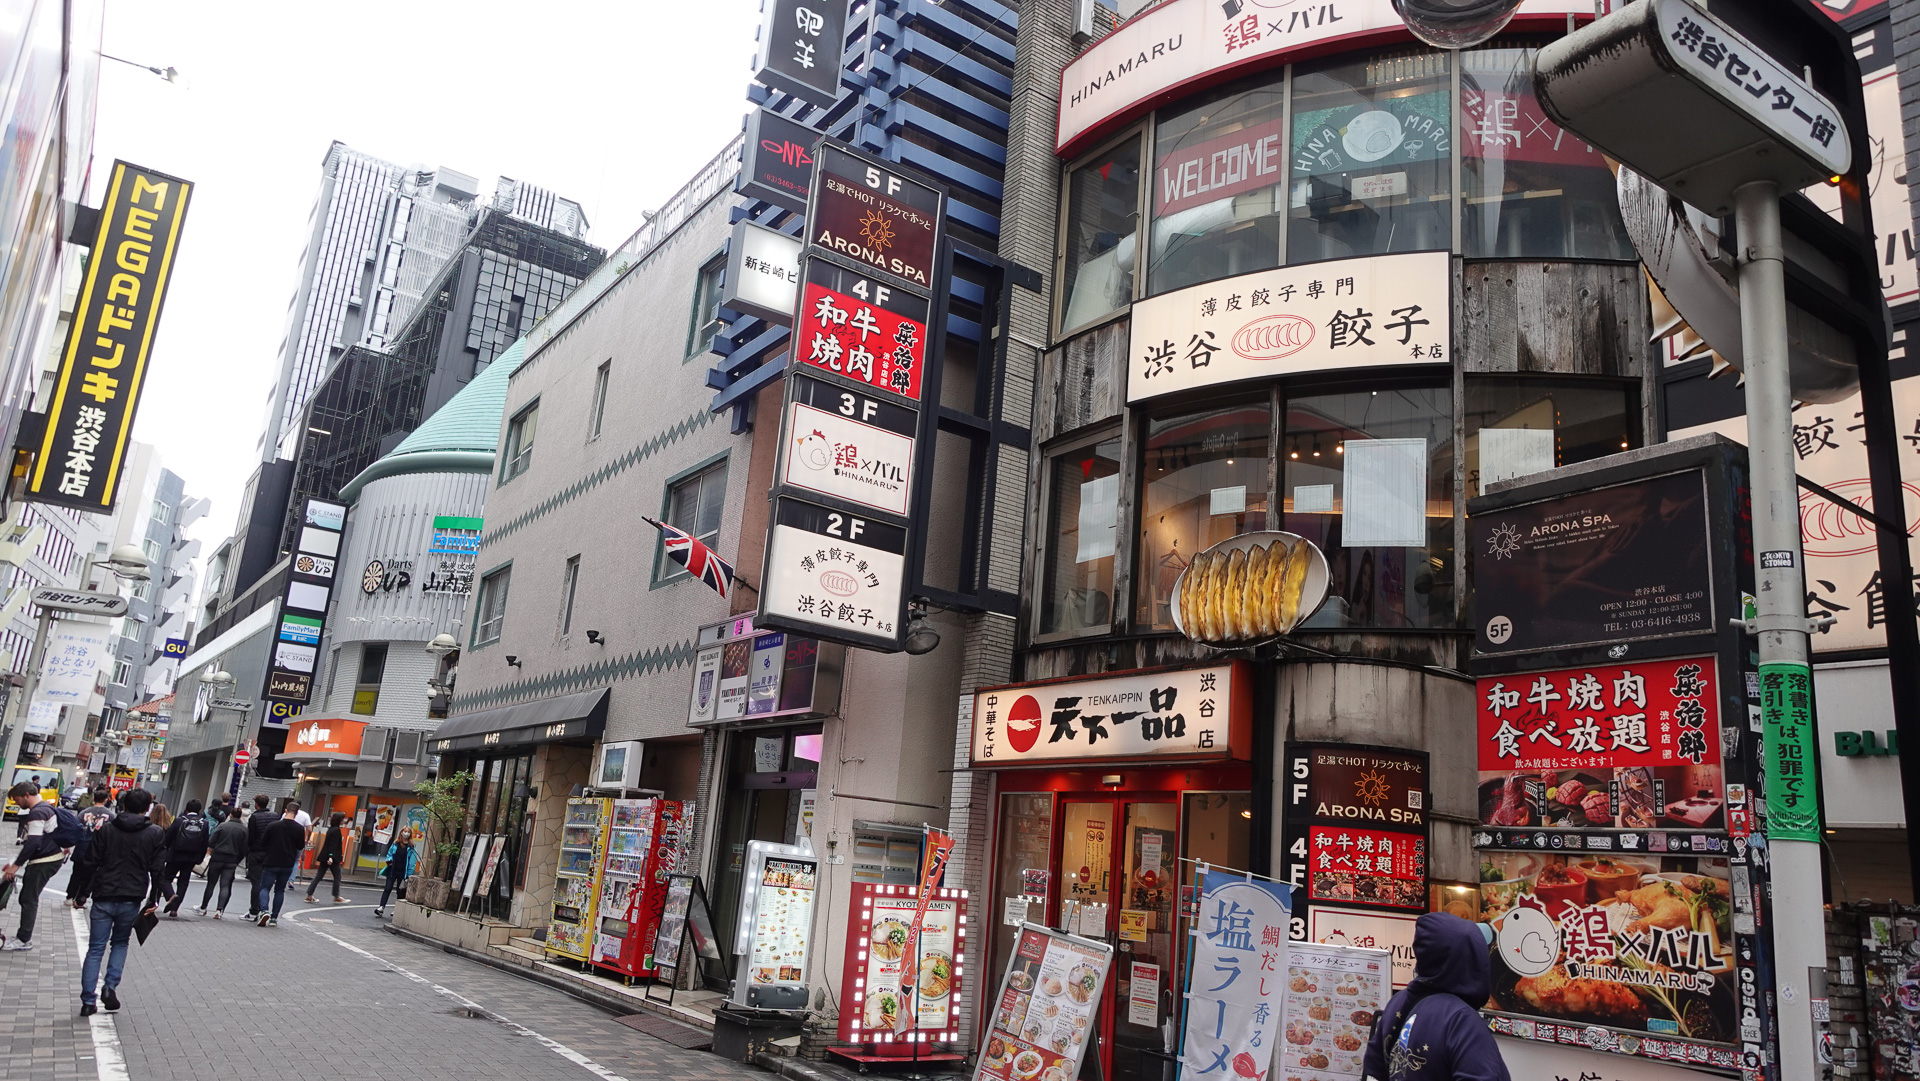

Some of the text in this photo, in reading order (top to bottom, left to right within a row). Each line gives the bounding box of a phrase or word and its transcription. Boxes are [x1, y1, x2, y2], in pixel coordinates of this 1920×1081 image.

[1223, 3, 1343, 54] 鶏×バル
[1070, 33, 1184, 109] HINAMARU
[1671, 16, 1837, 148] 渋谷センター街
[1404, 114, 1450, 152] MARU
[1294, 128, 1336, 172] HINA
[1163, 133, 1278, 204] WELCOME
[825, 178, 875, 205] 足湯でHOT
[818, 230, 926, 284] ARONA SPA
[852, 279, 890, 306] 4F
[1201, 276, 1354, 317] 薄皮餃子専門
[813, 294, 882, 343] 和牛
[58, 174, 169, 497] MEGAドンキ 渋谷本店
[1143, 304, 1430, 380] 渋谷 餃子
[808, 331, 876, 383] 焼肉
[1409, 342, 1444, 360] 本店
[838, 392, 878, 421] 3F
[834, 441, 905, 483] 鶏×バル
[840, 469, 893, 491] HINAMARU
[825, 513, 865, 540] 2F
[1530, 513, 1612, 538] ARONA SPA
[315, 558, 333, 567] Darts
[315, 565, 331, 575] UP
[387, 558, 413, 569] Darts
[799, 546, 880, 589] 薄皮餃子専門
[382, 571, 411, 593] UP
[1635, 584, 1666, 597] 渋谷本店
[36, 590, 121, 609] 渋谷センター街
[797, 593, 893, 633] 渋谷餃子 本店
[1600, 590, 1704, 612] OPEN 12:00 CLOSE 4:00
[1604, 611, 1701, 632] TEL 03-6416-4938
[1618, 608, 1647, 619] SUNDAY
[283, 623, 319, 635] FamilyMart
[1489, 622, 1509, 638] 5F
[64, 644, 88, 657] 渋谷
[166, 643, 186, 654] GU
[47, 667, 93, 678] サンデー
[49, 656, 96, 669] おとなり
[1087, 692, 1143, 706] TENKAIPPIN
[1486, 670, 1649, 719] 和牛焼肉
[1764, 673, 1785, 726] 客引き
[1788, 673, 1809, 726] 落書き
[272, 702, 301, 718] GU
[1048, 686, 1186, 745] 天下一品
[1197, 672, 1216, 749] 渋谷店
[983, 694, 998, 759] 中華そば
[1489, 712, 1652, 760] 食べ放題
[1659, 709, 1672, 745] 渋谷店
[1317, 755, 1367, 767] 足湯でHOT
[1514, 757, 1615, 769] 飲み放題もございます！
[1777, 725, 1806, 808] は、犯罪です
[1315, 802, 1423, 825] ARONA SPA
[1314, 832, 1394, 856] 和牛焼肉
[1316, 850, 1394, 875] 食べ放題
[896, 900, 918, 909] KYOT
[1558, 904, 1727, 970] 鶏×バル
[1311, 956, 1361, 968] ランチメニュー
[1582, 965, 1700, 992] HINAMARU
